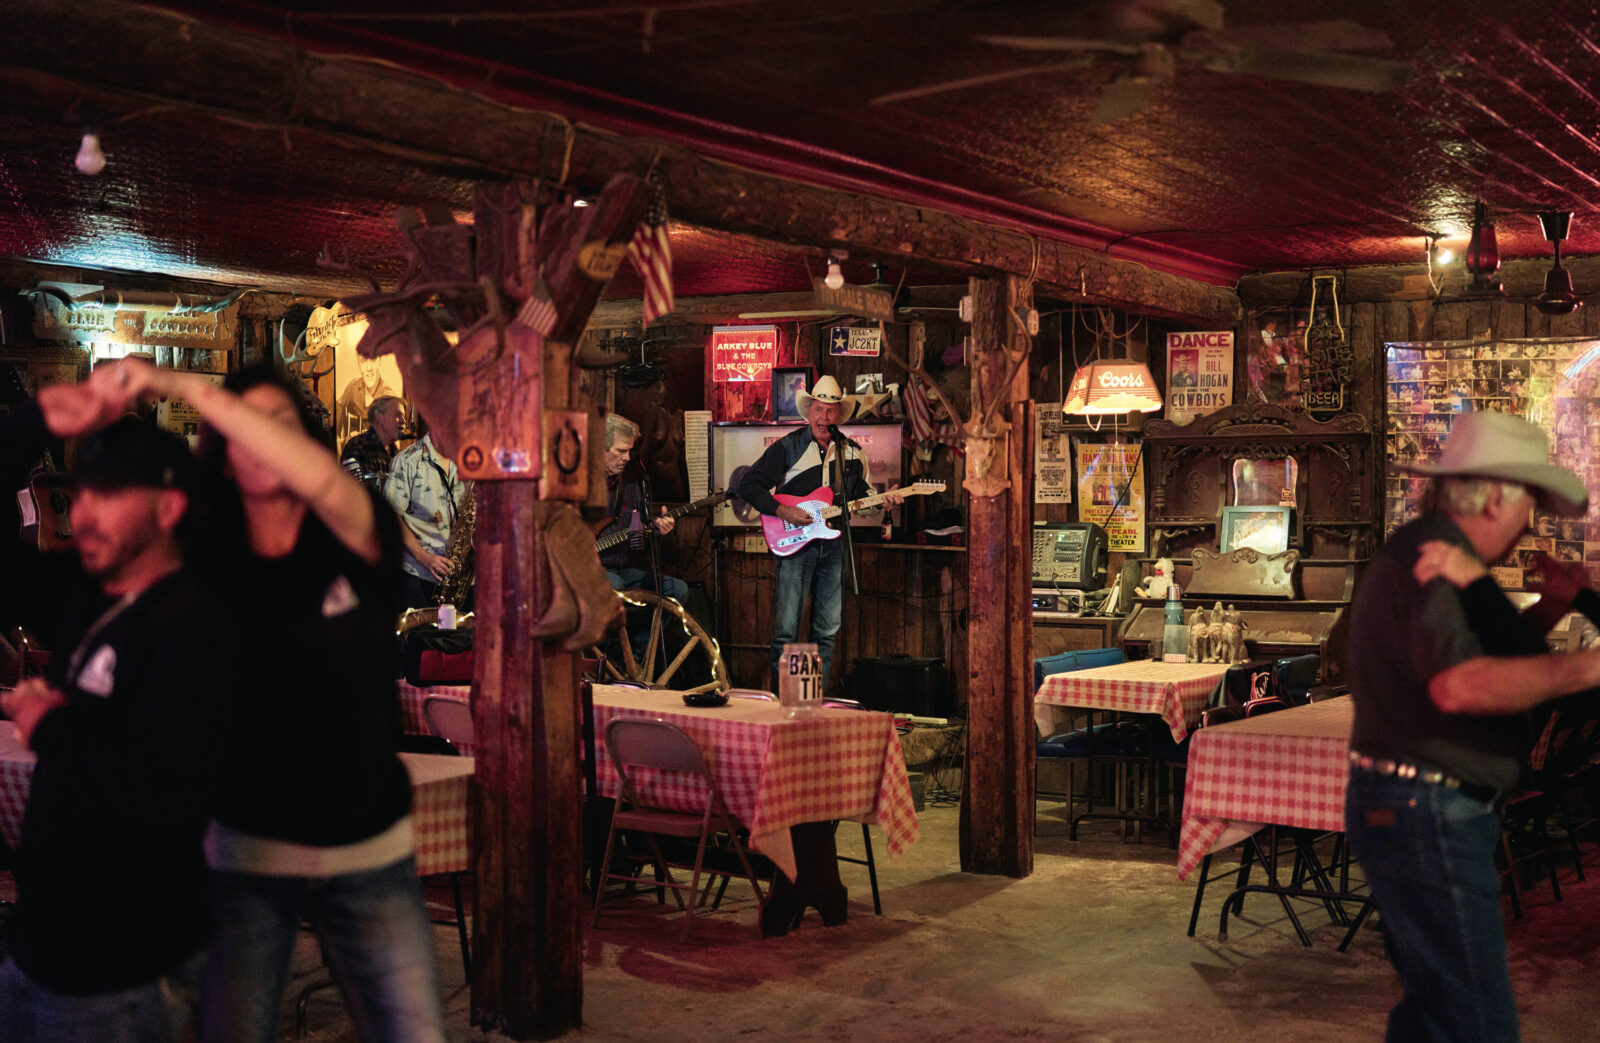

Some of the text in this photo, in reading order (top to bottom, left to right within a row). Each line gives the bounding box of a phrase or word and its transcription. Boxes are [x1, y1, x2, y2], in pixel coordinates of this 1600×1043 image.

[717, 341, 772, 351] ARKEY BLUE
[1170, 333, 1230, 348] DANCE
[741, 352, 755, 360] THE
[737, 362, 772, 370] COWBOYS
[1206, 361, 1223, 372] BILL
[1098, 371, 1145, 388] Coors
[1200, 373, 1229, 388] HOGAN
[1171, 393, 1226, 407] COWBOYS
[1308, 391, 1340, 406] BEER
[1082, 453, 1138, 464] HANK WILLIAMS
